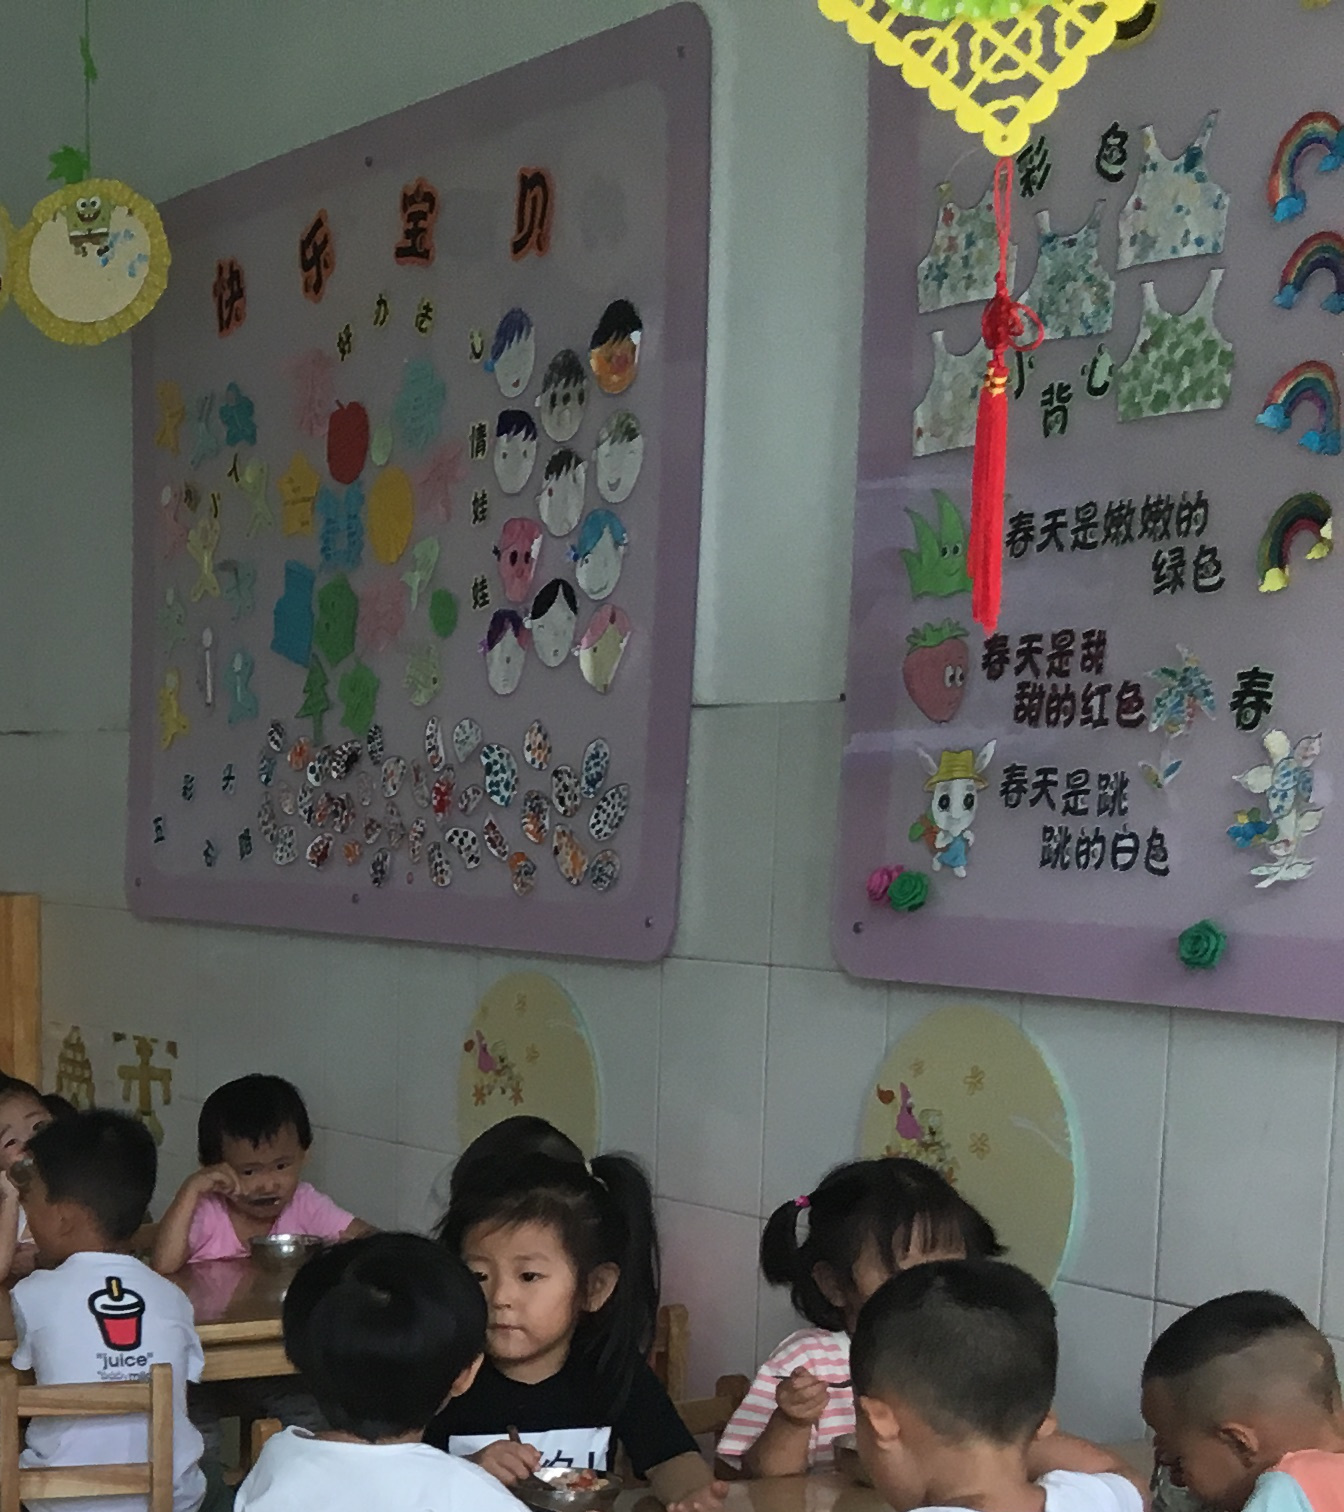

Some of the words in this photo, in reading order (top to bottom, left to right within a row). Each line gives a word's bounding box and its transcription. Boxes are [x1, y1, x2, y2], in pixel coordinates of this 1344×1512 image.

[1015, 122, 1129, 197] 彩色
[214, 168, 552, 337] 快乐宝贝
[1005, 490, 1209, 558] 春天是嫩嫩的
[1152, 544, 1226, 596] 绿色
[982, 629, 1108, 681] 春天是甜
[1014, 681, 1148, 729] 甜的红色
[1229, 667, 1275, 731] 春
[1000, 763, 1129, 817] 春天是跳
[1039, 824, 1171, 876] 跳的白色
